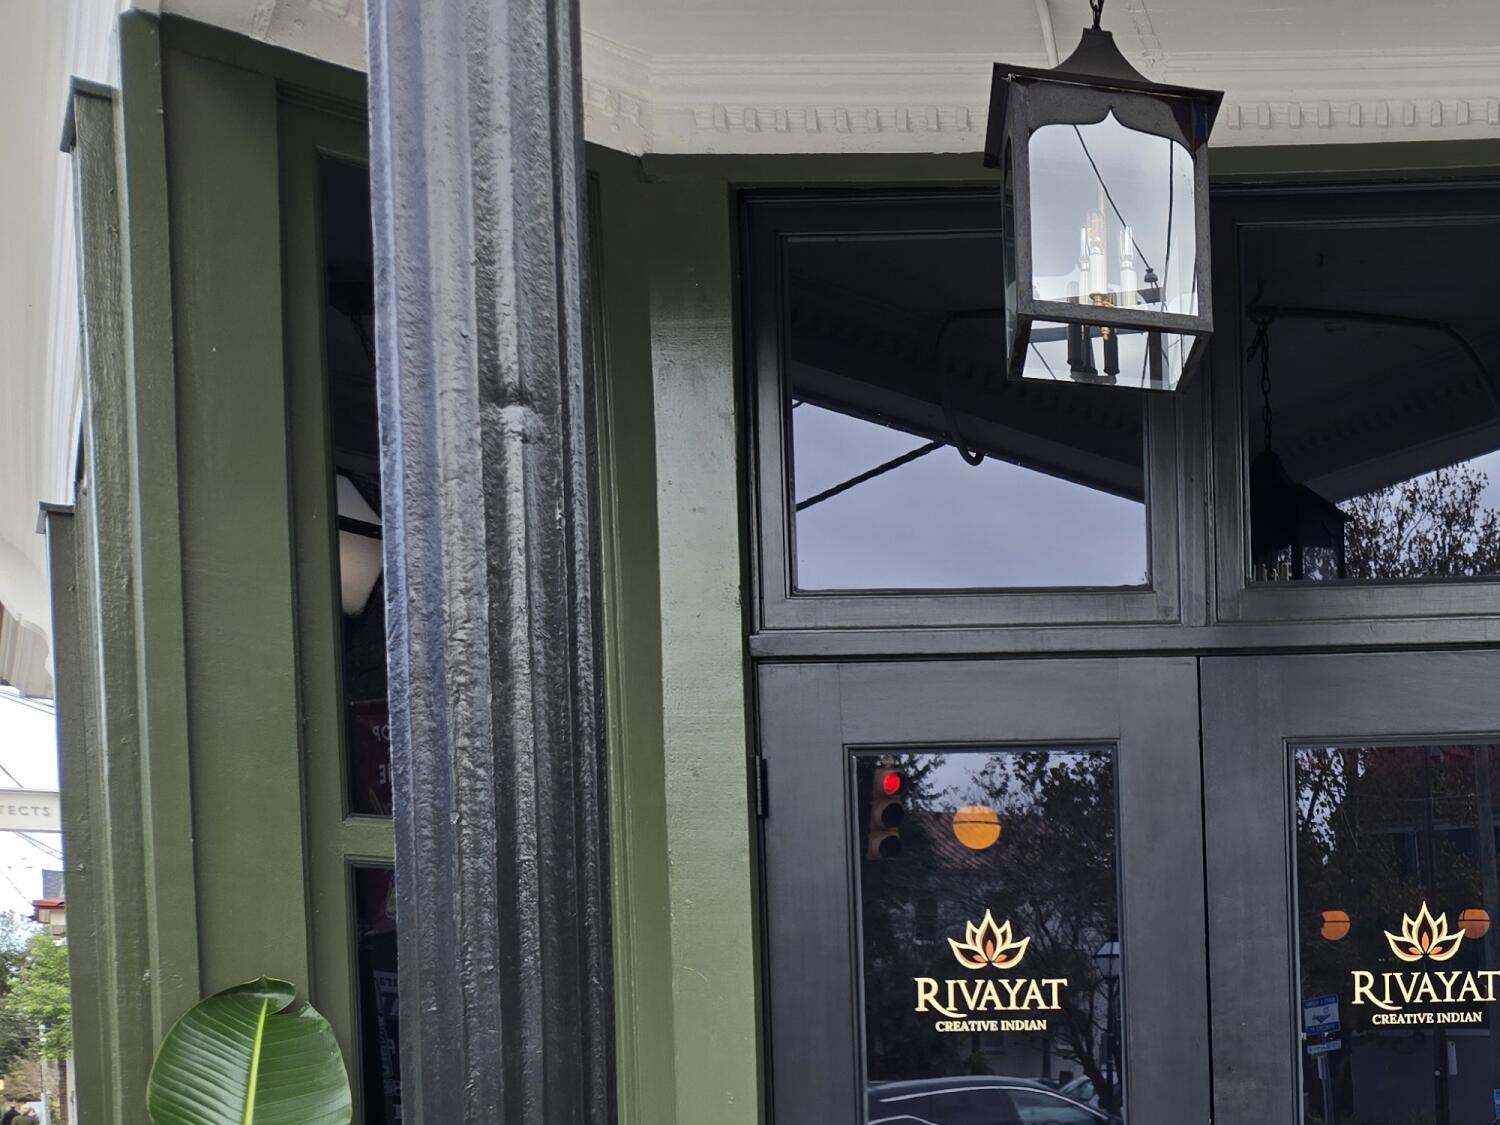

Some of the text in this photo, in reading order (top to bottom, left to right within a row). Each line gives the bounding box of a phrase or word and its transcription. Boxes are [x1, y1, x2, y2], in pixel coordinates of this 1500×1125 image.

[913, 977, 1068, 1018] RIVAYAT
[1372, 1012, 1482, 1025] CREATIVE INDIAN
[935, 1020, 1047, 1032] CREATIVE INDIAN
